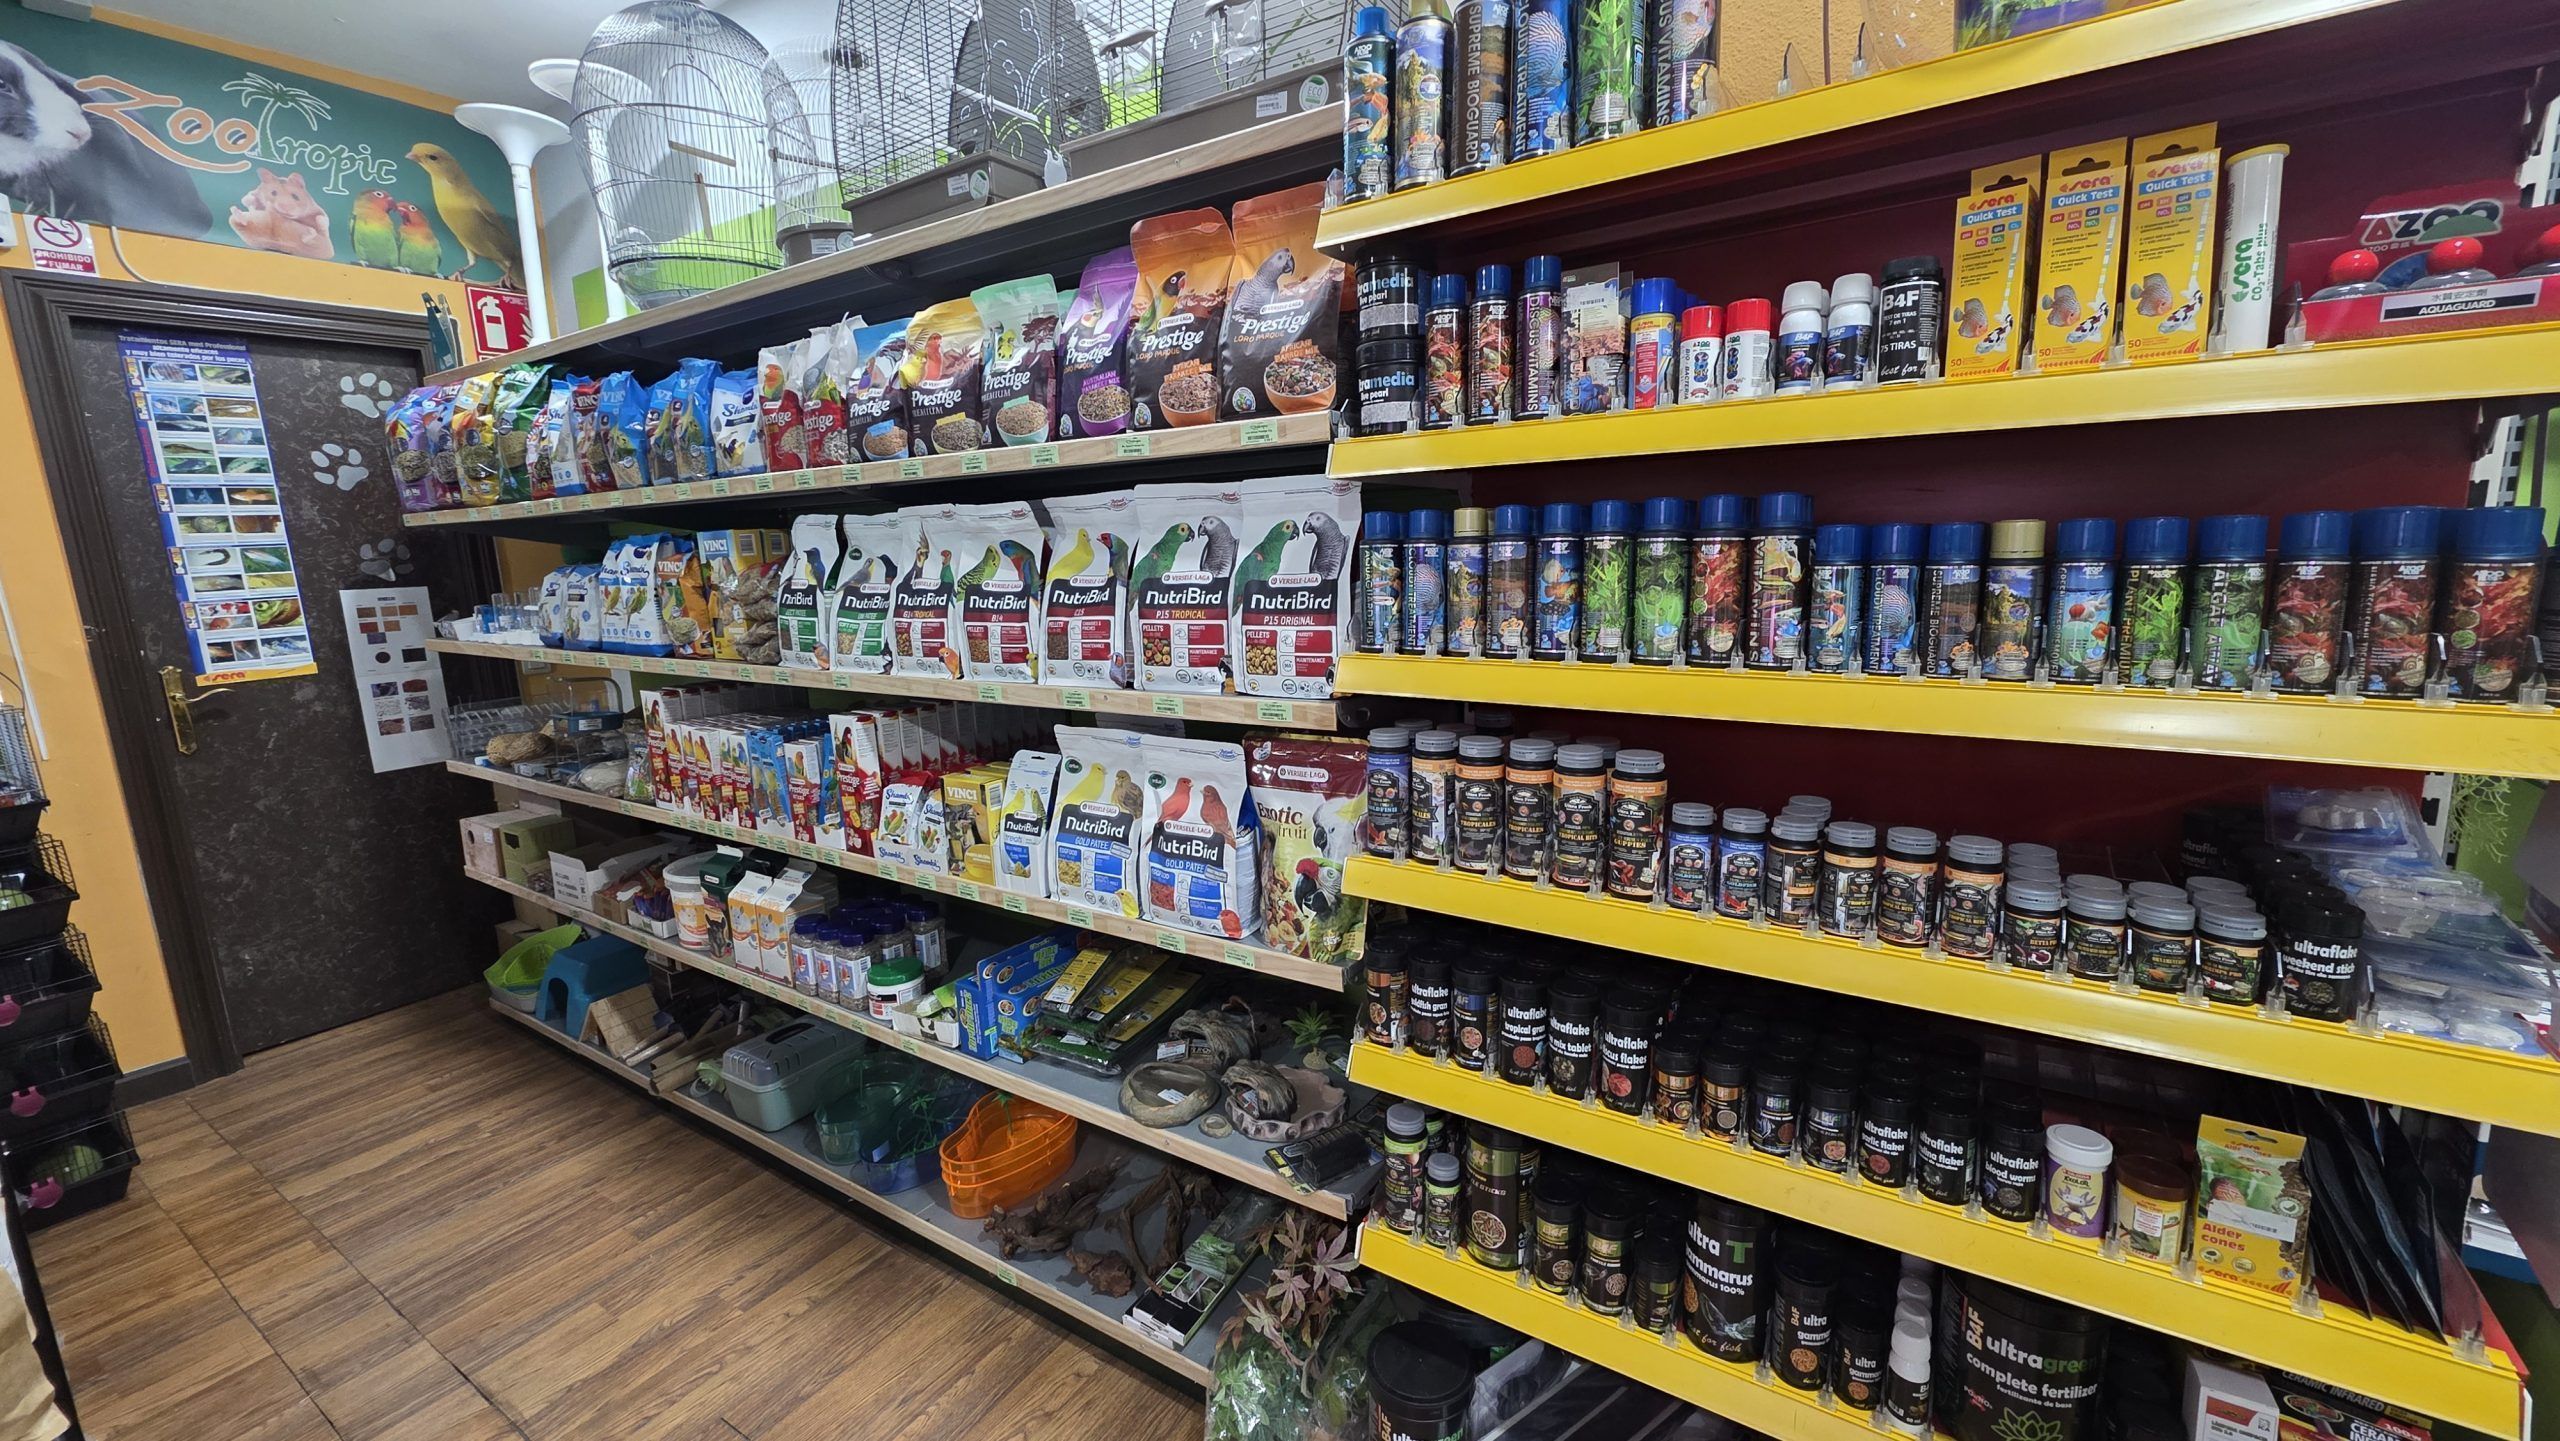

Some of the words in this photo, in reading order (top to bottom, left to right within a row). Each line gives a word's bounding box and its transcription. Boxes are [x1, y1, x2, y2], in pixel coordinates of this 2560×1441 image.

[1468, 5, 1481, 75] SUPREME
[1656, 37, 1673, 127] VITAMINS
[1515, 62, 1528, 152] TREATMENT
[75, 74, 258, 172] Zoo
[1466, 79, 1480, 163] BIOGUARD
[2069, 176, 2111, 191] sera
[2146, 178, 2177, 193] Quick
[2181, 173, 2206, 184] Test
[1976, 194, 2015, 210] sera
[2058, 193, 2087, 206] Quick
[2090, 188, 2113, 199] Test
[1967, 212, 1994, 225] Quick
[1995, 206, 2017, 218] Test
[2361, 199, 2502, 245] AZOO
[35, 250, 92, 263] PROHIBIDO
[2233, 238, 2254, 289] sera
[49, 261, 84, 271] FUMAR
[1369, 290, 1388, 303] pearl
[1883, 290, 1919, 311] B4F
[2419, 300, 2495, 316] AQUAGUARD
[1241, 312, 1311, 335] Prestige
[1528, 296, 1541, 345] DISCUS
[119, 335, 168, 345] Tratamientos
[1142, 327, 1204, 351] Prestige
[1234, 333, 1255, 343] LORO
[1256, 331, 1284, 341] PARQUE
[2128, 339, 2141, 348] 50
[1880, 345, 1889, 353] 75
[1890, 340, 1917, 351] TIRAS
[2039, 348, 2051, 357] 50
[1066, 346, 1113, 365] Prestige
[1950, 358, 1962, 367] 50
[1881, 365, 1900, 376] best
[1901, 363, 1918, 376] for
[984, 369, 1030, 391] Prestige
[1082, 371, 1116, 386] AUSTRALIAN
[1526, 349, 1539, 411] VITAMINS
[912, 387, 961, 408] Prestige
[1370, 388, 1389, 400] pearl
[850, 399, 890, 419] Prestige
[703, 538, 728, 551] VINCI
[1171, 573, 1211, 582] VERSELE-LAGA
[1278, 576, 1319, 585] VERSELE-LAGA
[1053, 588, 1110, 604] NutriBird
[1146, 588, 1222, 605] NutriBird
[1873, 568, 1885, 609] CLOUDY
[1930, 570, 1943, 616] SUPREME
[782, 593, 813, 606] NutriBird
[898, 593, 947, 607] NutriBird
[969, 595, 1027, 610] NutriBird
[1251, 591, 1332, 610] NutriBird
[1750, 542, 1765, 661] VITAMINS
[2207, 569, 2226, 628] ALGAE
[914, 610, 935, 618] TROPICAL
[1156, 610, 1169, 619] P15
[1171, 609, 1206, 620] TROPICAL
[1263, 616, 1279, 625] P15
[1280, 615, 1315, 625] ORIGINAL
[1407, 588, 1417, 645] TREATMENT
[1247, 630, 1270, 638] PELLETS
[1366, 619, 1374, 644] PLUS
[1869, 612, 1882, 671] TREATMENT
[1927, 619, 1939, 674] BIOGUARD
[2118, 617, 2133, 684] PREMIUM
[2202, 634, 2222, 685] AWAY
[211, 671, 246, 682] sera
[837, 771, 860, 787] Prestige
[1287, 768, 1326, 780] VERSELE-LAGA
[947, 787, 977, 801] VINCI
[1257, 803, 1303, 825] Exotic
[1006, 820, 1039, 835] NutriBird
[1065, 816, 1125, 838] NutriBird
[1173, 822, 1212, 835] VERSELE-LAGA
[1461, 820, 1496, 828] TROPICALES
[1508, 824, 1544, 833] TROPICALES
[1278, 825, 1307, 840] fruit
[1559, 833, 1584, 841] TROPICAL
[1075, 837, 1091, 847] GOLD
[1091, 839, 1109, 850] PATEE
[1157, 836, 1218, 861] NutriBird
[1614, 838, 1646, 848] GUPPIES
[1165, 859, 1184, 868] GOLD
[1185, 862, 1205, 873] PATEE
[2283, 954, 2334, 971] weekend
[1411, 983, 1448, 998] ultraflake
[1432, 1003, 1448, 1012] gran
[1504, 1020, 1530, 1034] tropical
[1555, 1039, 1566, 1050] mix
[1567, 1042, 1592, 1053] tablet
[1604, 1032, 1648, 1050] ultraflake
[1620, 1051, 1647, 1065] flakes
[1864, 1120, 1908, 1141] ultraflake
[1880, 1138, 1905, 1152] flakes
[1938, 1153, 1964, 1167] flakes
[1990, 1151, 2039, 1170] ultraflake
[1985, 1163, 2008, 1179] blood
[2009, 1170, 2036, 1184] worms
[1480, 1185, 1507, 1196] STICKS
[1688, 1221, 1720, 1256] ultra
[2201, 1222, 2242, 1240] Alder
[2201, 1232, 2246, 1252] cones
[2205, 1267, 2240, 1283] sera
[1720, 1284, 1745, 1296] 100%
[1803, 1314, 1827, 1327] ultra
[1965, 1305, 1985, 1351] B4F
[1702, 1331, 1718, 1347] for
[1720, 1336, 1743, 1353] fish
[1855, 1356, 1876, 1369] ultra
[1966, 1352, 2037, 1394] complete
[2041, 1382, 2098, 1400] fertilizer
[1996, 1384, 2042, 1407] fertilizante
[2043, 1400, 2054, 1408] de
[2055, 1401, 2073, 1409] base
[2282, 1370, 2328, 1393] CERAMIC
[2330, 1385, 2385, 1412] INFRARED
